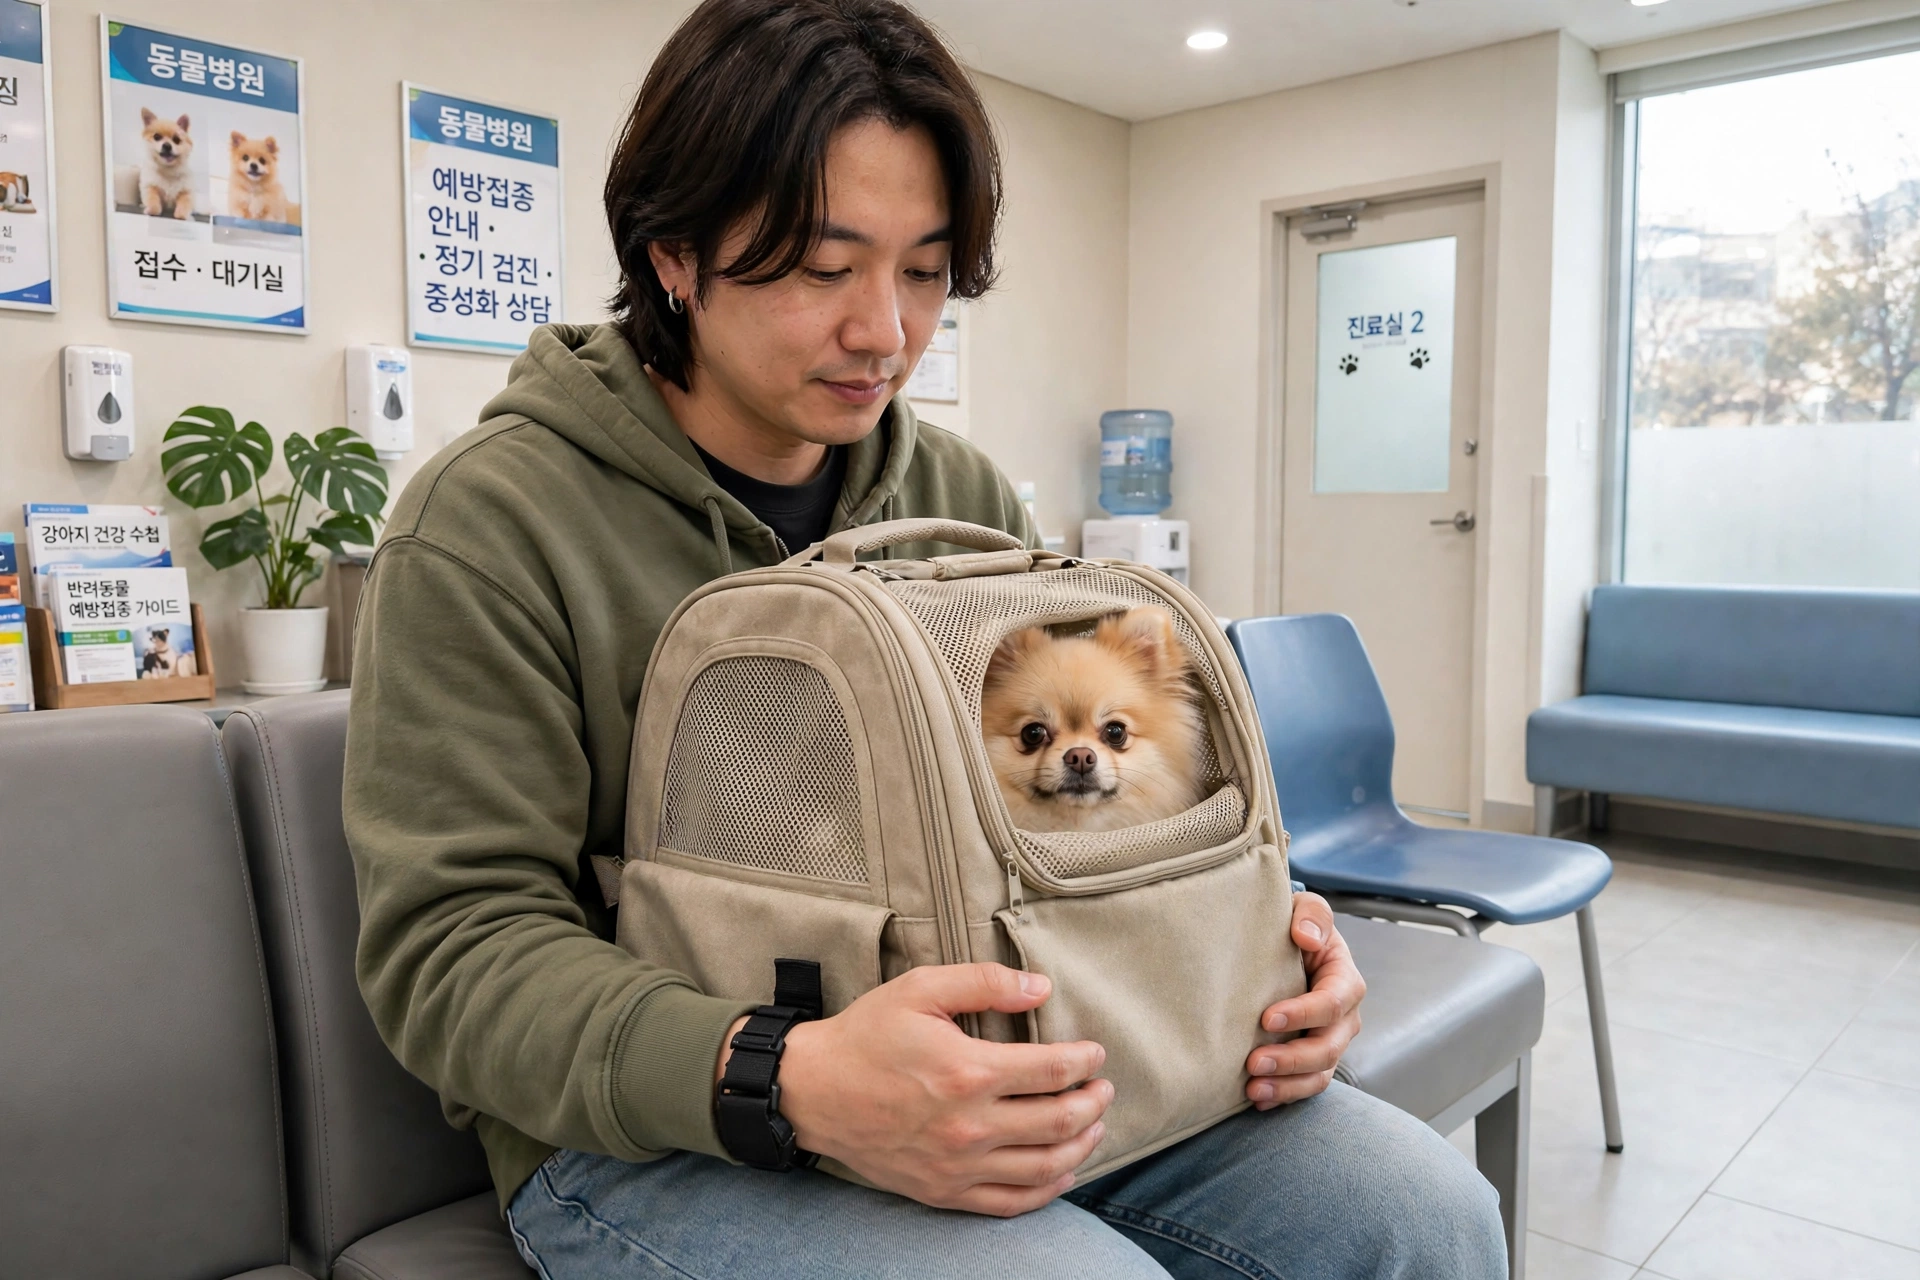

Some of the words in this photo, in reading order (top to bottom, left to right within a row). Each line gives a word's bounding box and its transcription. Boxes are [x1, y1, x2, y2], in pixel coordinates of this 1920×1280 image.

[147, 42, 265, 97] 동물병원
[438, 105, 533, 153] 동물병원
[432, 167, 535, 213] 예방접종
[428, 205, 478, 242] 안내
[134, 250, 187, 281] 접수
[212, 260, 284, 293] 대기실
[435, 244, 483, 280] 정기
[492, 253, 539, 286] 검진
[424, 281, 499, 319] 중성화
[506, 292, 552, 324] 상담
[1347, 312, 1403, 340] 진료실
[1411, 310, 1424, 333] 2
[42, 525, 89, 544] 강아지
[94, 525, 126, 544] 건강
[130, 525, 160, 543] 수첩
[67, 580, 130, 599] 반려동물
[69, 600, 132, 620] 예방접종
[136, 598, 181, 618] 가이드
